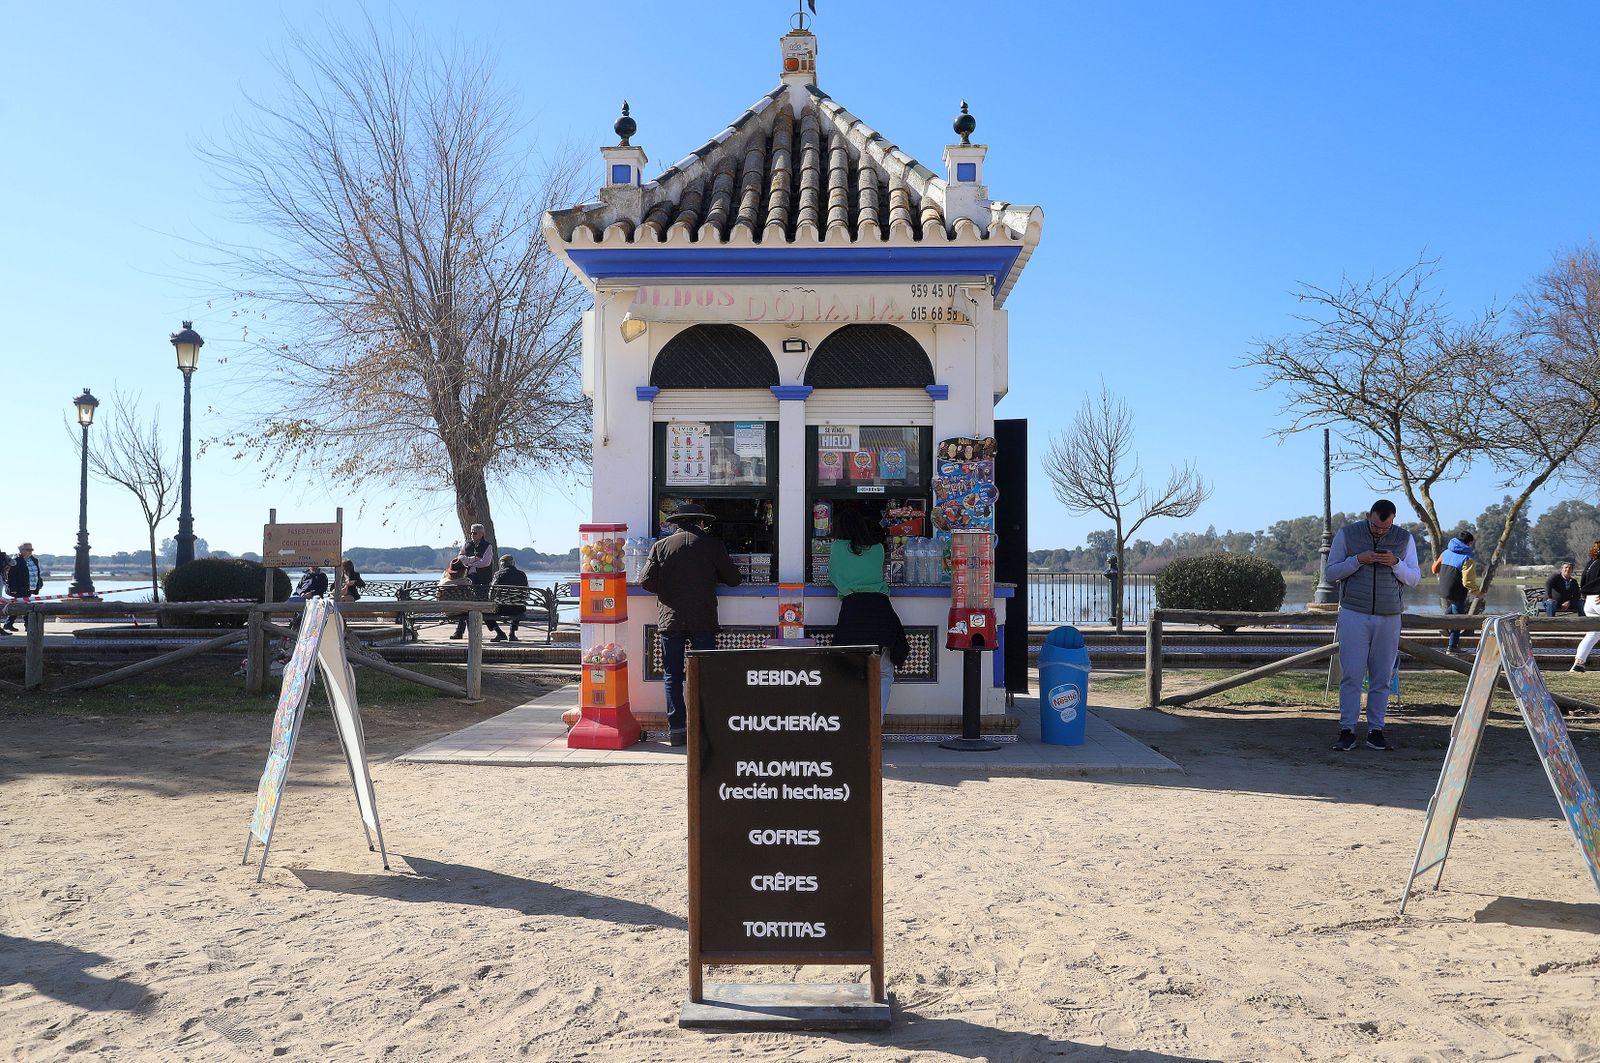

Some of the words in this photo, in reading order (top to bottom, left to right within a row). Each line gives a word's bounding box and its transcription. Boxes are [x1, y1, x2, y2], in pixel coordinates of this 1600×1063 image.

[911, 284, 928, 298] 959
[932, 284, 943, 298] 45
[911, 306, 927, 320] 615
[931, 306, 943, 320] 68
[821, 435, 849, 447] HIELO
[746, 669, 822, 686] BEBIDAS
[1053, 691, 1078, 706] Nestlé
[728, 712, 841, 732] CHUCHERÍAS
[736, 760, 833, 777] PALOMITAS
[719, 782, 778, 801] (recién
[782, 783, 850, 801] hechas)
[748, 829, 821, 846] GOFRES
[750, 871, 819, 892] CRÊPES
[743, 921, 826, 938] TORTITAS
